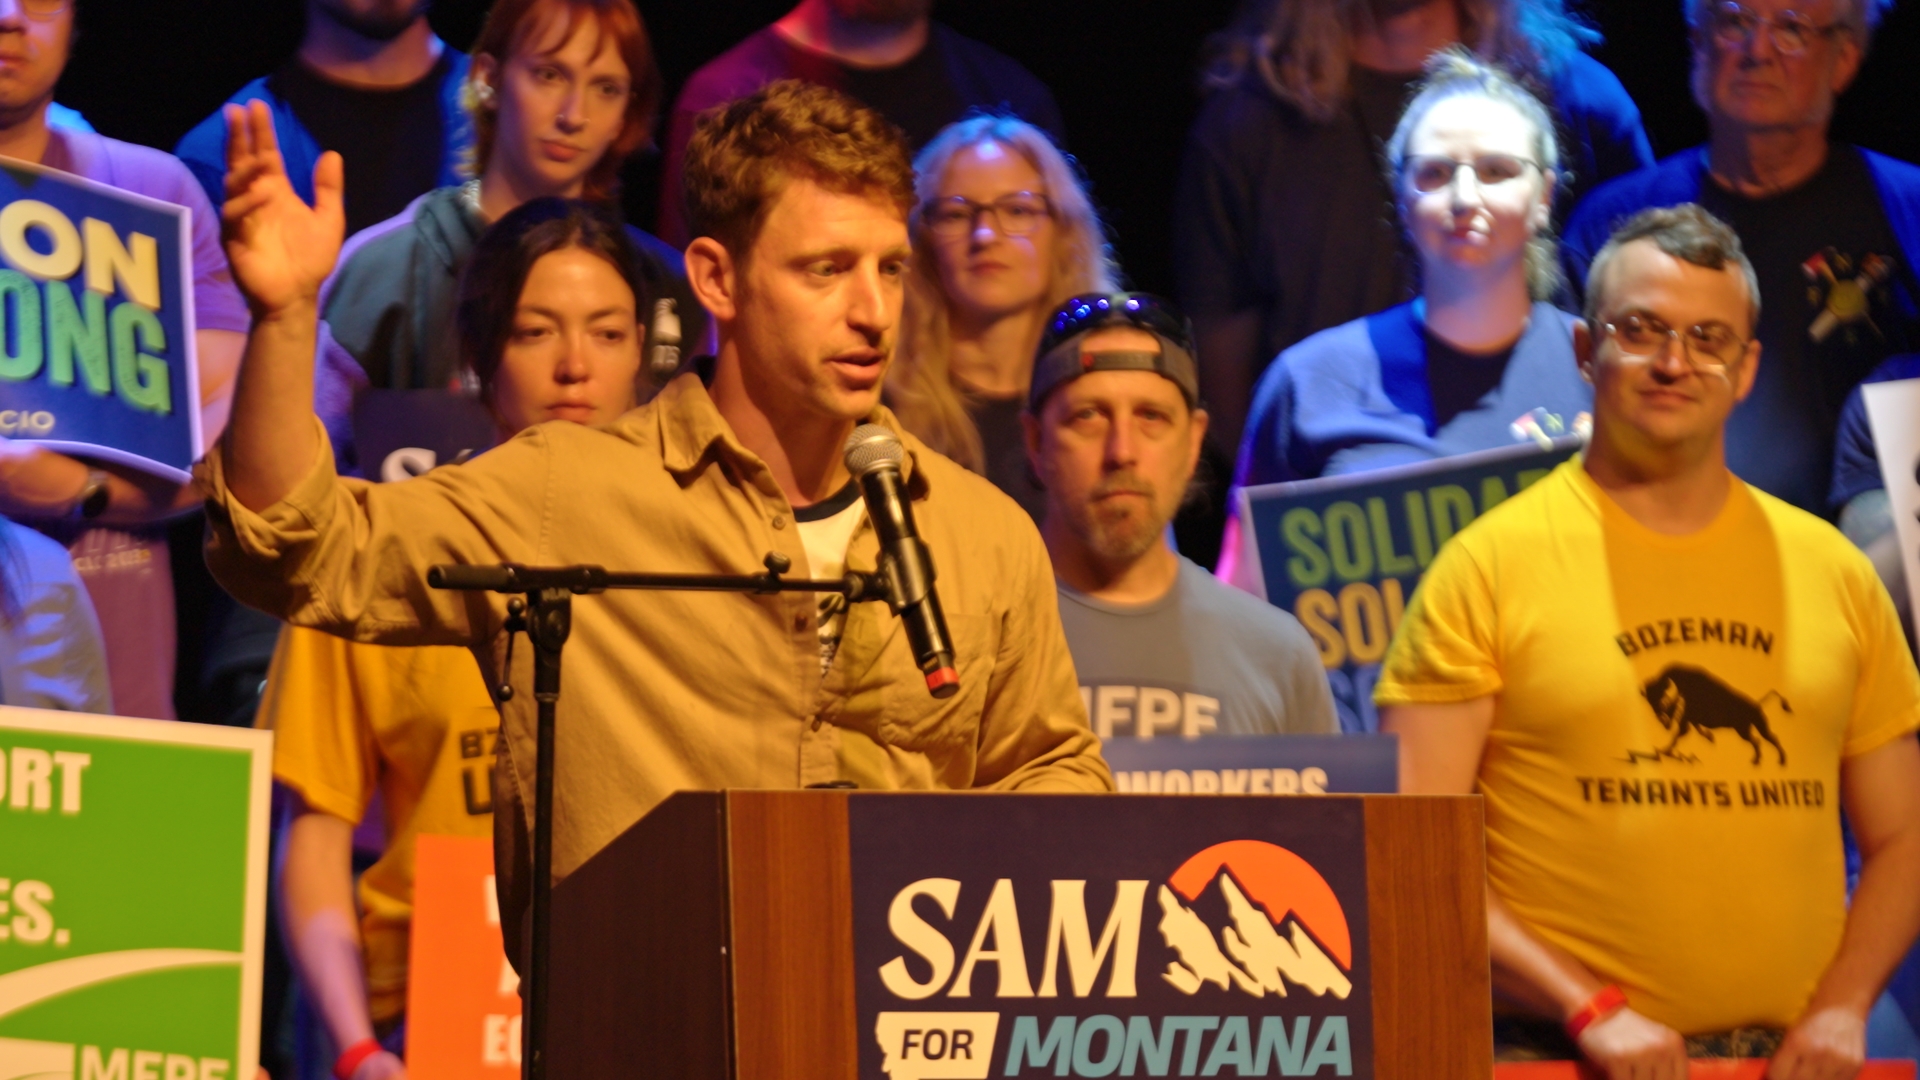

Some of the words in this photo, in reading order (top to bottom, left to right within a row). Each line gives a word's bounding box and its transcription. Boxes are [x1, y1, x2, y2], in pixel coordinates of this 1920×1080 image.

[0, 199, 160, 311] ON
[0, 268, 171, 415] ONG
[1281, 468, 1555, 587] SOLID
[1615, 617, 1774, 656] BOZEMAN
[1080, 685, 1220, 739] FPE
[0, 746, 91, 814] RT
[1576, 776, 1731, 806] TENANTS
[1740, 779, 1824, 807] UNITED
[879, 877, 1149, 999] SAM
[900, 1029, 974, 1060] FOR
[1004, 1014, 1354, 1077] MONTANA
